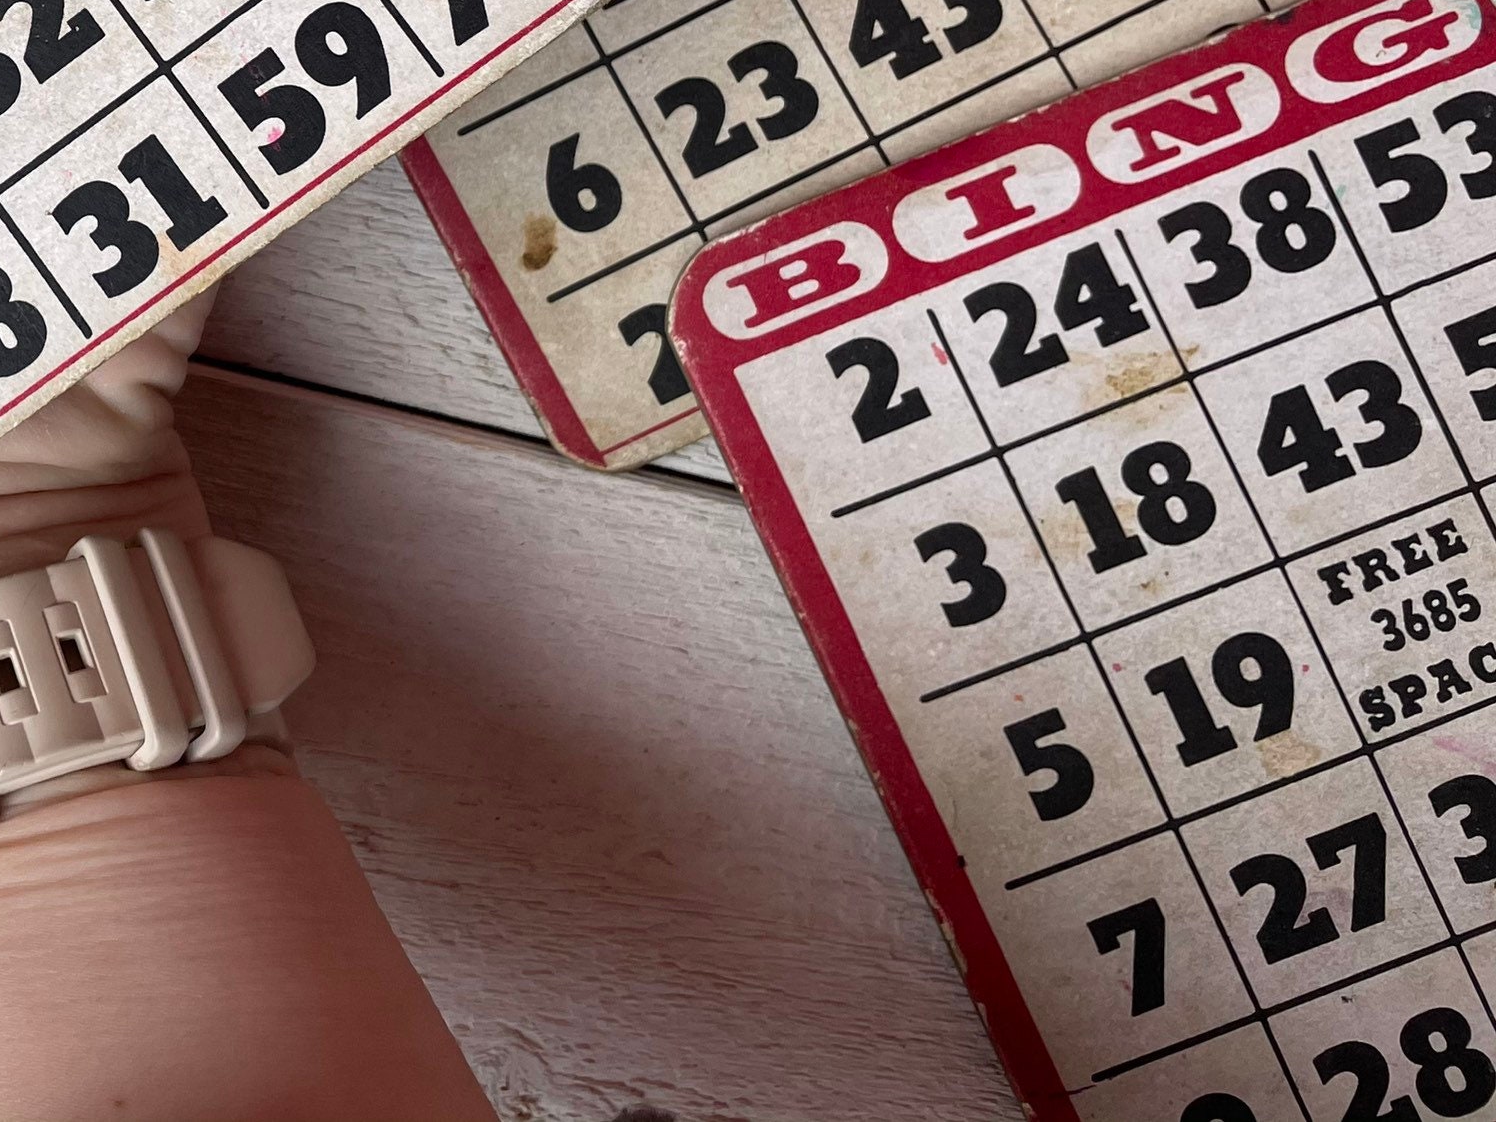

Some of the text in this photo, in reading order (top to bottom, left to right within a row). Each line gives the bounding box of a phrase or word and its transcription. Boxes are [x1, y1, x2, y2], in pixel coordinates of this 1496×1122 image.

[52, 134, 228, 298] 31
[218, 2, 391, 175] 59
[546, 133, 622, 232] 6
[654, 41, 819, 178] 23
[826, 91, 1496, 443] 2 24 38 53
[914, 523, 1006, 627] 3
[1056, 442, 1216, 574] 18
[1258, 361, 1422, 493] 43
[1317, 519, 1468, 605] FREE
[1371, 578, 1481, 651] 3685
[1004, 632, 1294, 821] 5 19
[1086, 897, 1165, 1017] 7
[1229, 812, 1386, 965] 27
[1313, 1007, 1496, 1122] 28
